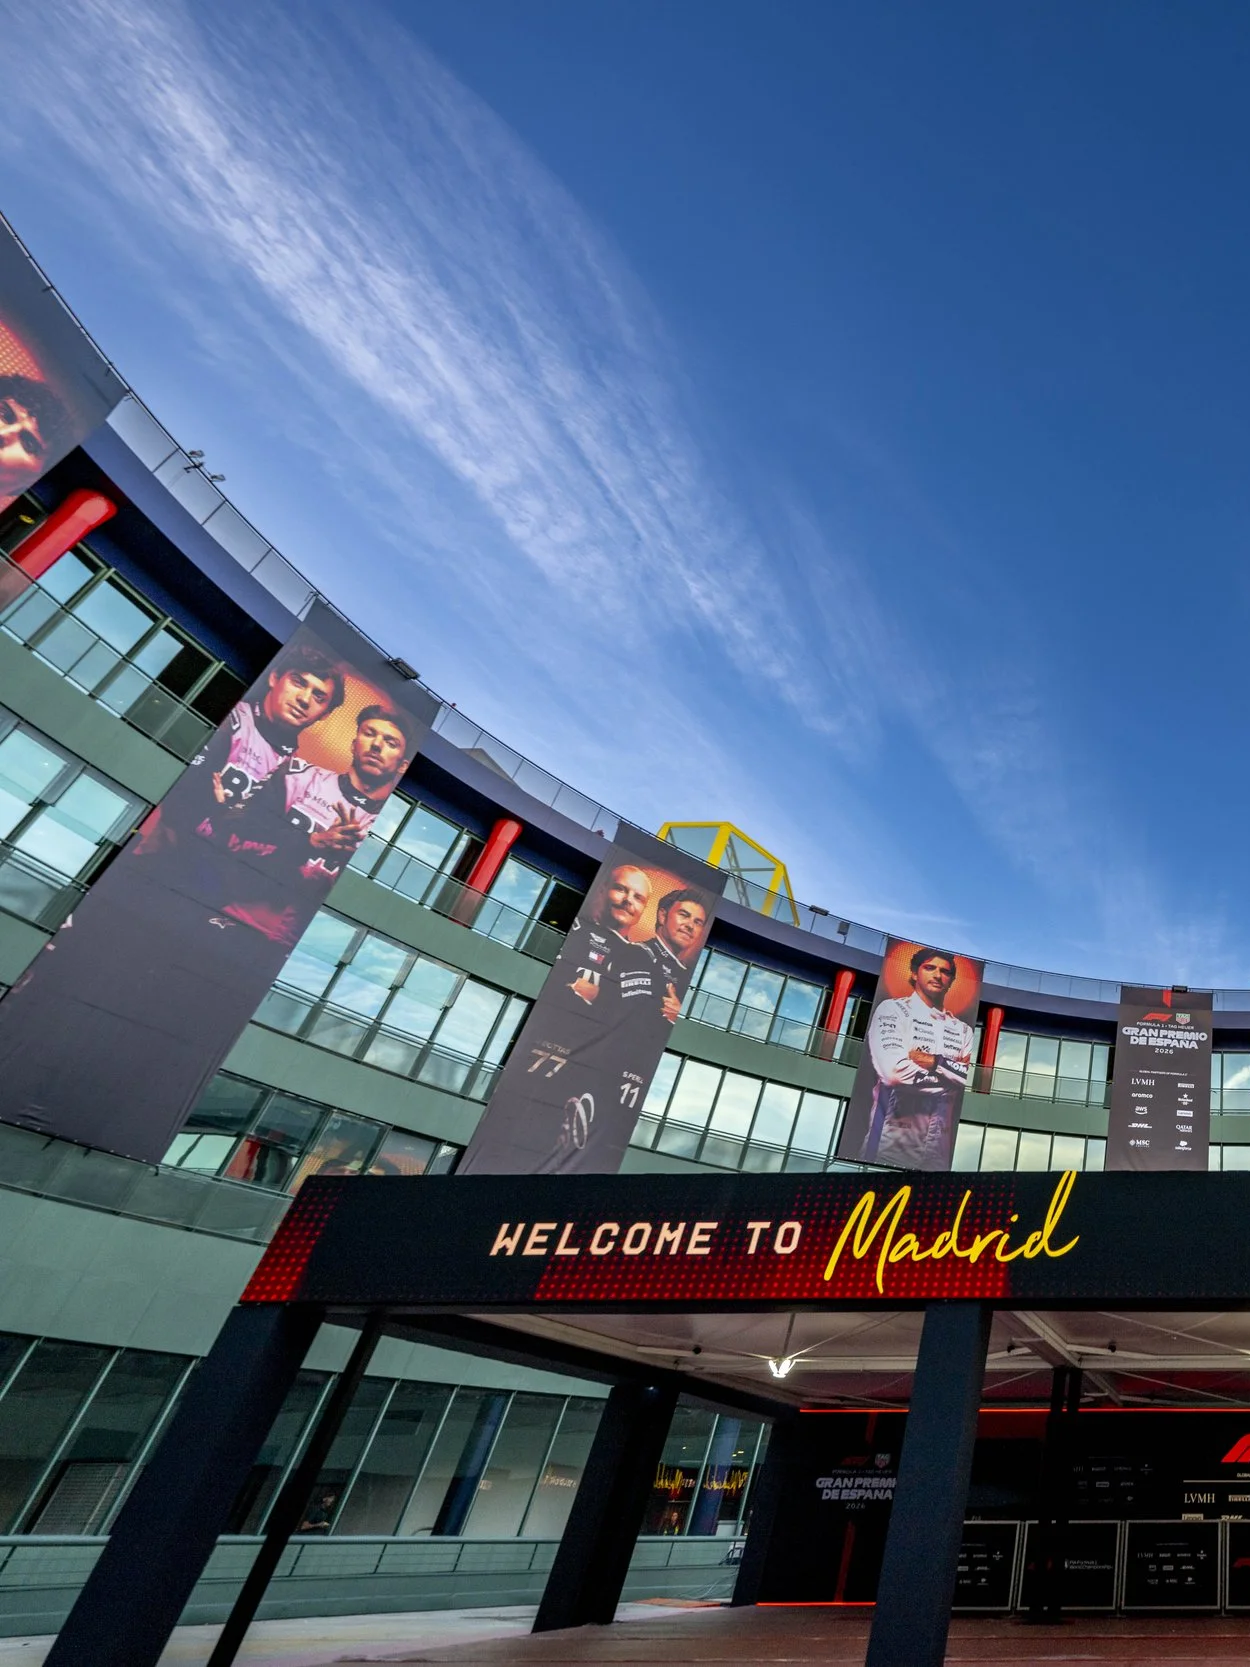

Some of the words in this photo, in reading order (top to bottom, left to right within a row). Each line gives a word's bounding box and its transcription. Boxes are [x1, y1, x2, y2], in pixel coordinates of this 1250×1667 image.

[1122, 1026, 1158, 1037] GRAN
[1160, 1029, 1208, 1041] PREMIO
[1130, 1036, 1147, 1046] DE
[527, 1048, 567, 1078] 77
[1131, 1078, 1155, 1086] LVMH
[620, 1082, 640, 1109] 11
[490, 1221, 718, 1257] WELCOME
[745, 1221, 802, 1256] TO
[824, 1171, 1080, 1293] Madrid
[816, 1478, 854, 1488] GRAN
[854, 1478, 897, 1488] PREMI
[822, 1489, 840, 1500] DE
[1184, 1492, 1216, 1504] LVMH
[845, 1502, 866, 1510] 2026
